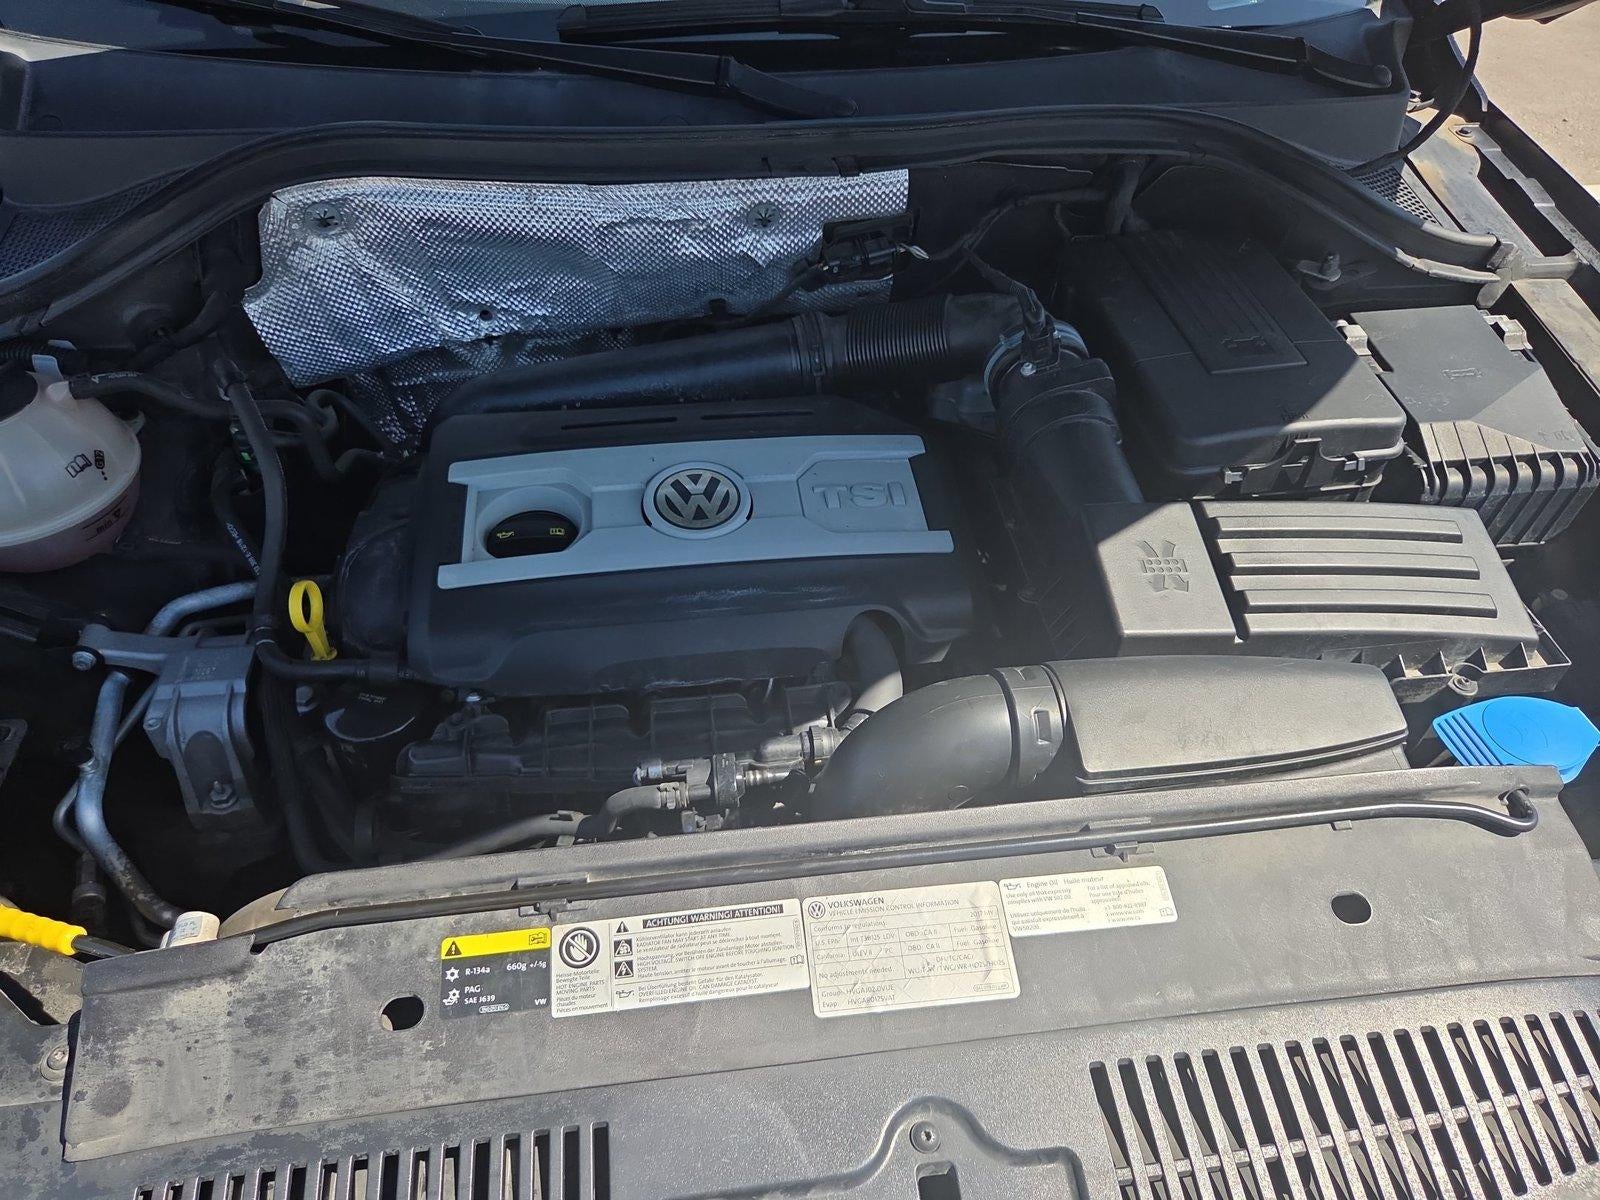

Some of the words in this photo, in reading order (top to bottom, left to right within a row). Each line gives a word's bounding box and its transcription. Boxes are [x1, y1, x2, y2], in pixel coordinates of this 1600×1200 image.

[811, 480, 908, 509] TSI
[1026, 880, 1049, 889] Engine
[1063, 877, 1081, 885] Huile
[827, 897, 885, 909] VOLKSWAGEN
[829, 908, 855, 916] VEHICLE
[855, 905, 885, 914] EMISSION
[885, 903, 915, 911] CONTROL
[915, 898, 960, 908] INFORMATION
[646, 915, 688, 927] ACHTUNG!
[691, 910, 732, 922] WARNING!
[734, 905, 780, 917] ATTENTION!
[813, 924, 843, 933] Conforms
[465, 966, 491, 976] R-134a
[506, 962, 527, 973] 660g
[818, 972, 828, 980] No
[464, 985, 481, 994] PAG
[464, 997, 477, 1005] SAE
[479, 995, 495, 1003] J639
